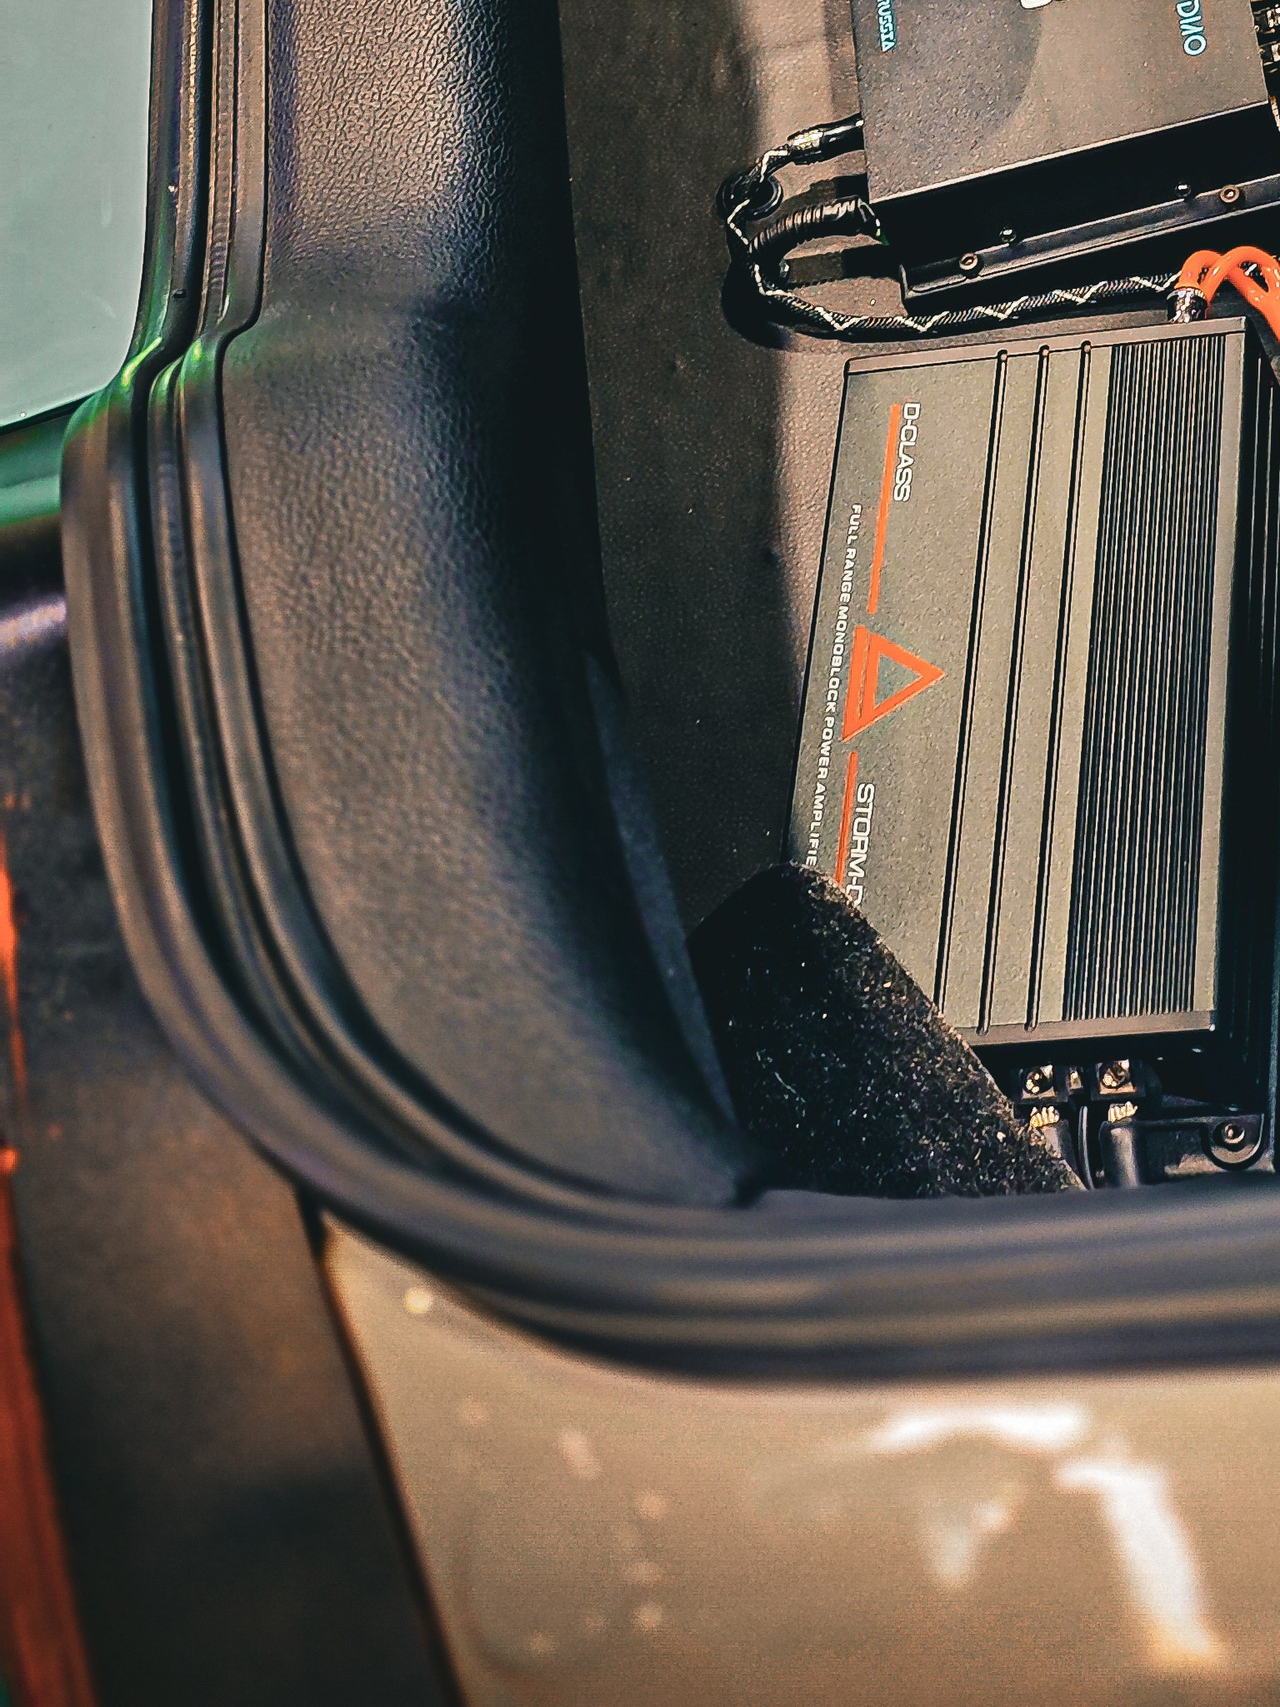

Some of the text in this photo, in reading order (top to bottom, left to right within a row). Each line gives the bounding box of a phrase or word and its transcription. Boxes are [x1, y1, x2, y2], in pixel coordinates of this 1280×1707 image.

[894, 402, 921, 502] D-CLASS
[804, 503, 862, 867] FULL RANGE MONOBLOCK POWER AMPLIFIE
[845, 783, 875, 905] STORM-D
